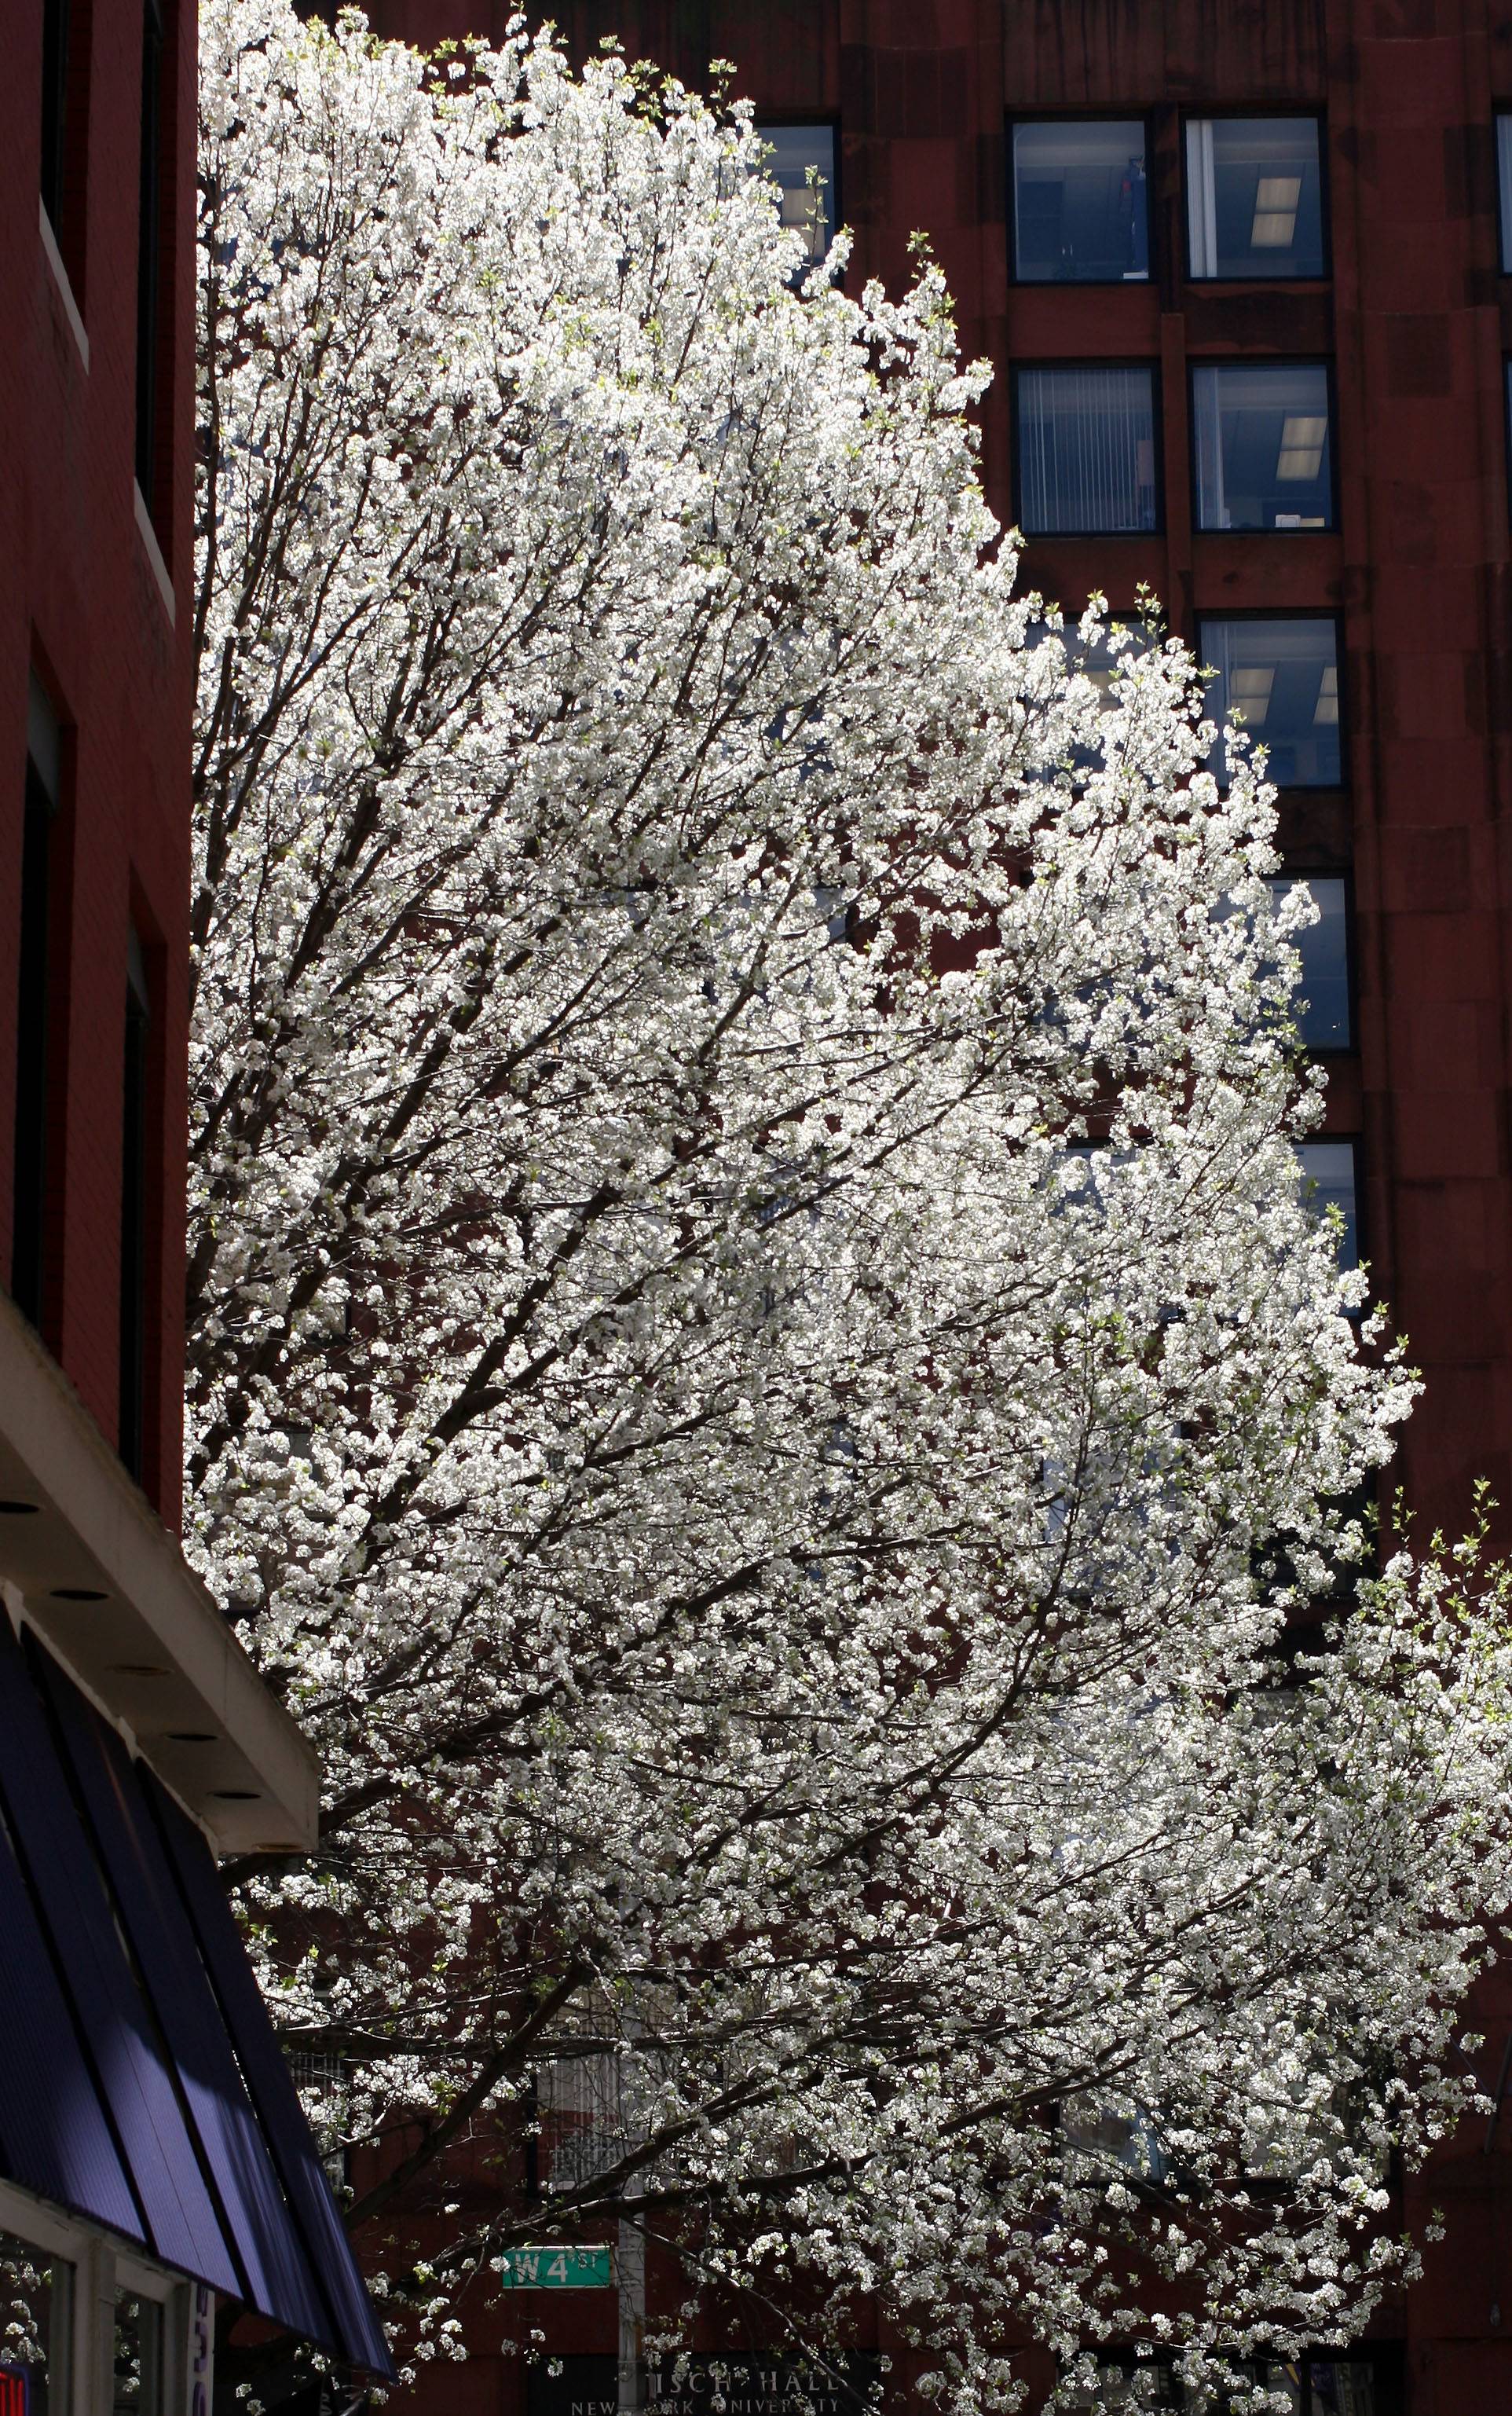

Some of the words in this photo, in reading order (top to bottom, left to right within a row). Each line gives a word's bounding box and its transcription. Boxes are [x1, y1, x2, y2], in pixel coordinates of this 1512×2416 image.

[514, 2253, 540, 2283] W
[547, 2253, 569, 2282] 4
[578, 2252, 599, 2268] ST
[644, 2371, 731, 2393] ISCH
[759, 2370, 839, 2392] HALL
[571, 2401, 616, 2416] NEW
[716, 2398, 839, 2414] NIVERSTY
